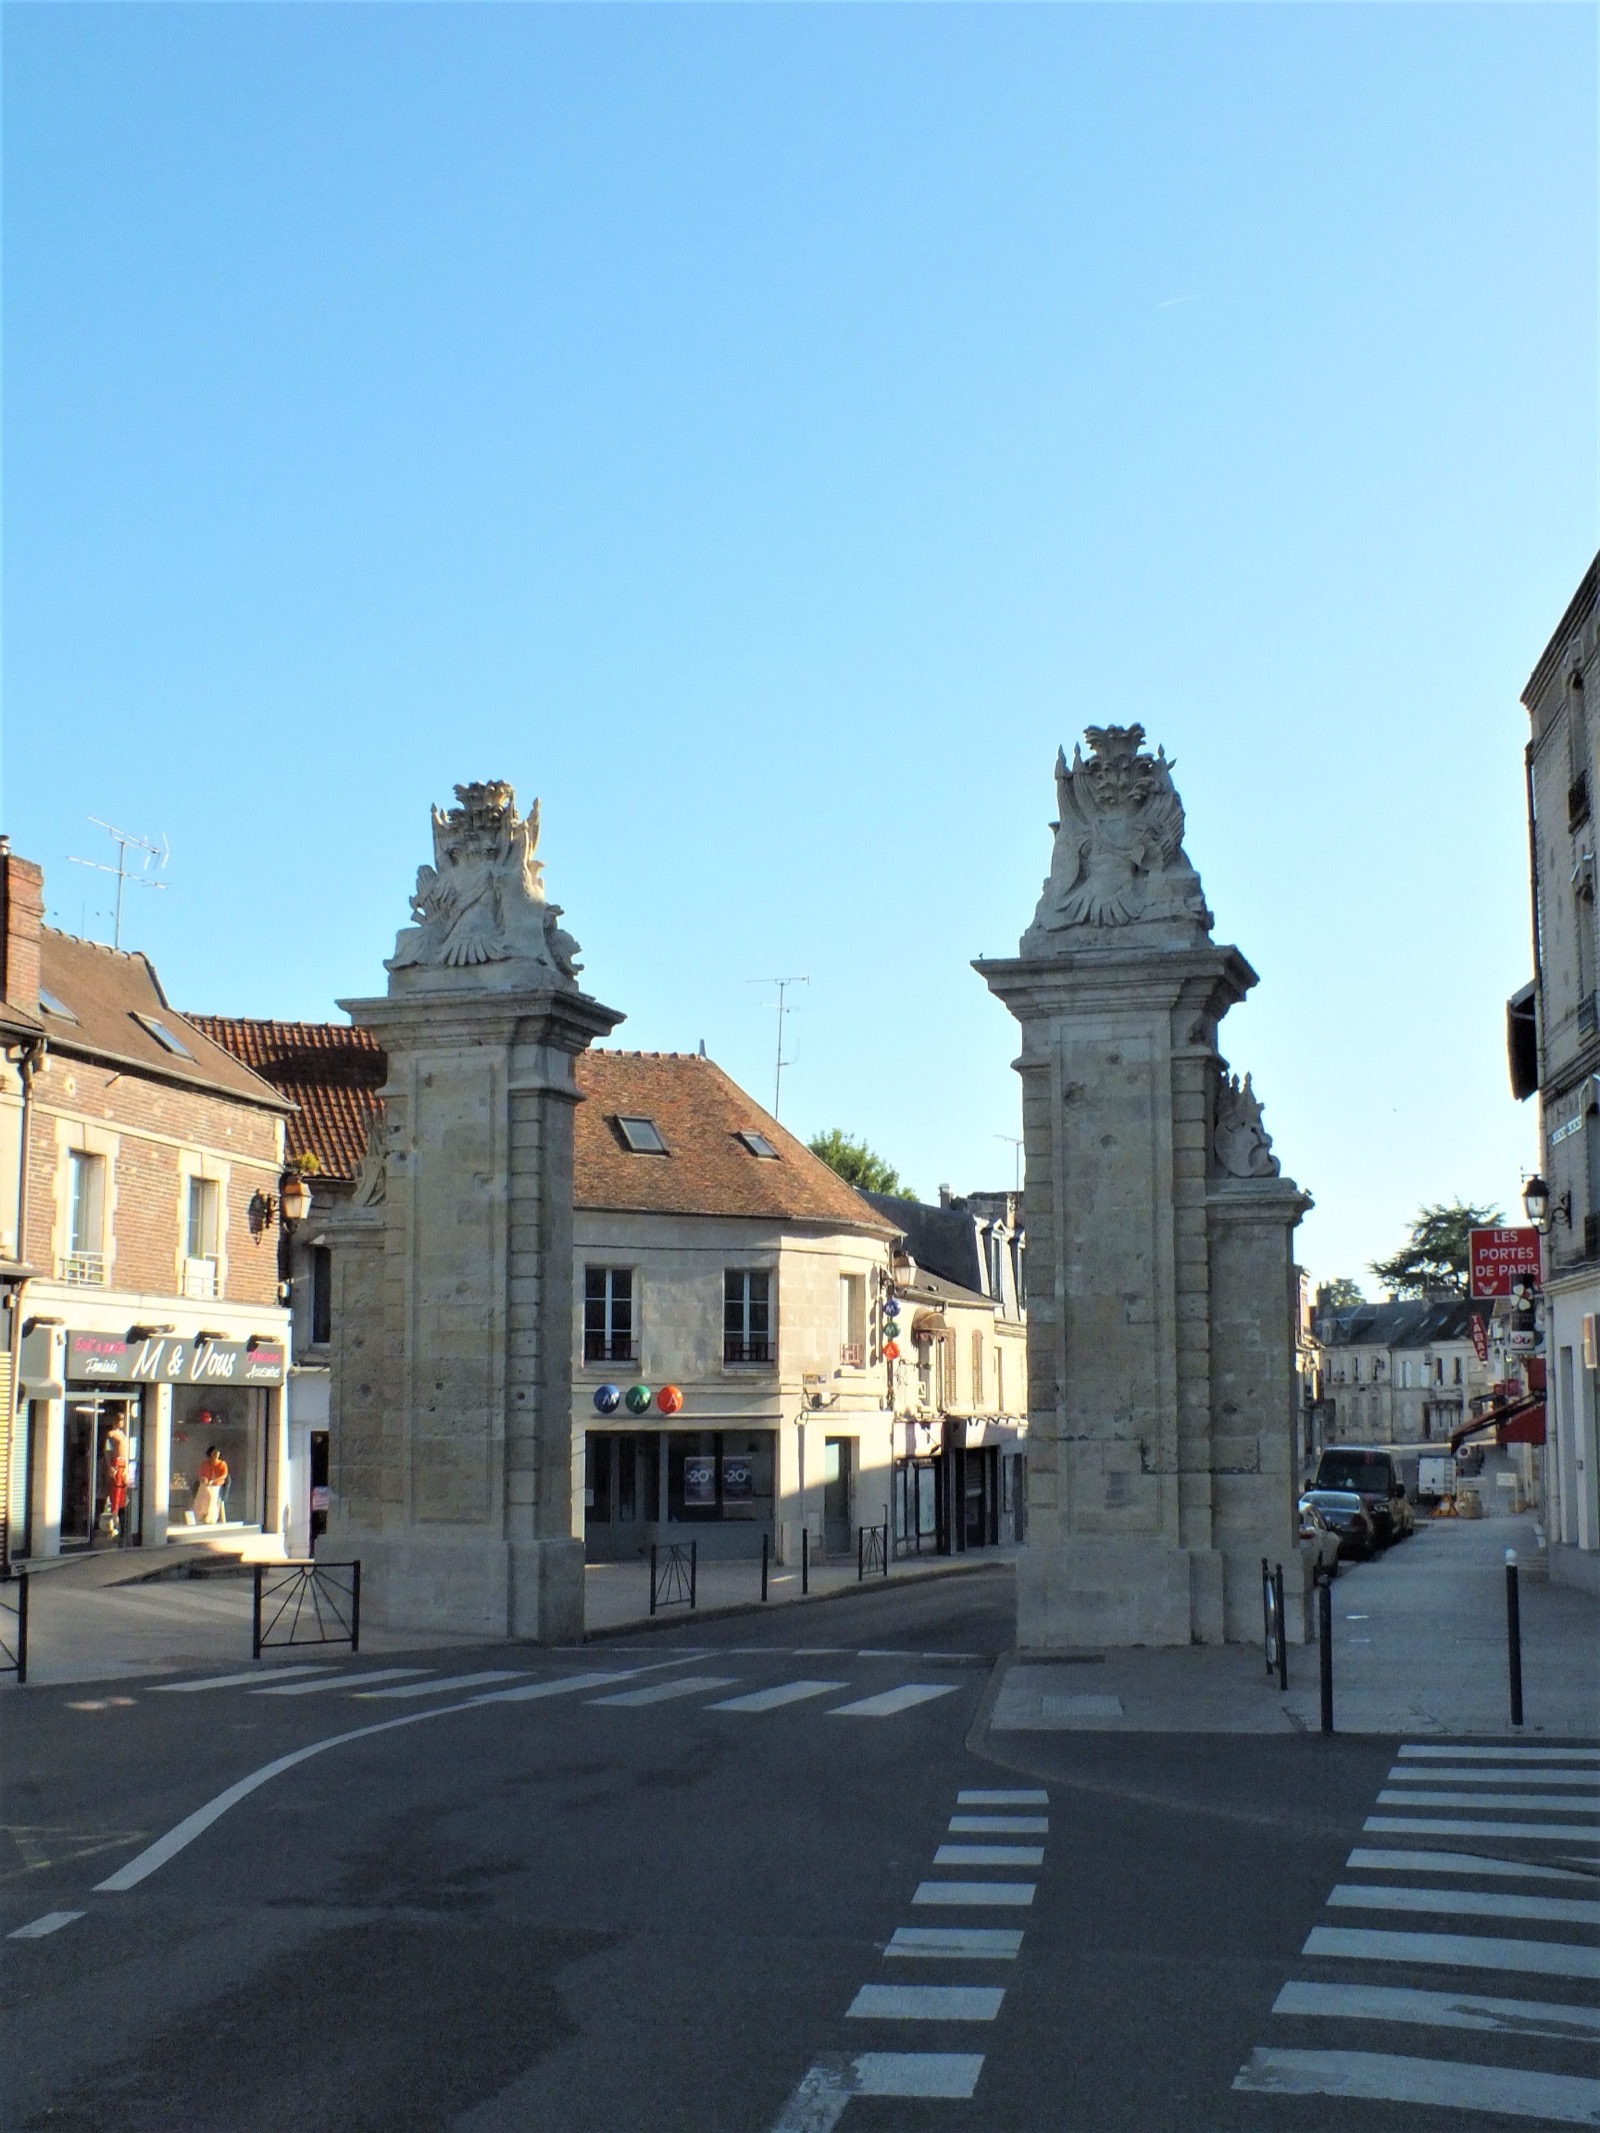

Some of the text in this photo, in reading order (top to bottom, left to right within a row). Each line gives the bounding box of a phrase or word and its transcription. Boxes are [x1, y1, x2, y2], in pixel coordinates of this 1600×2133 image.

[1493, 1231, 1518, 1243] LES
[1479, 1247, 1534, 1260] PORTES
[1475, 1263, 1539, 1277] DE PARIS
[1472, 1314, 1486, 1360] TABAC
[131, 1338, 236, 1380] M & Vous
